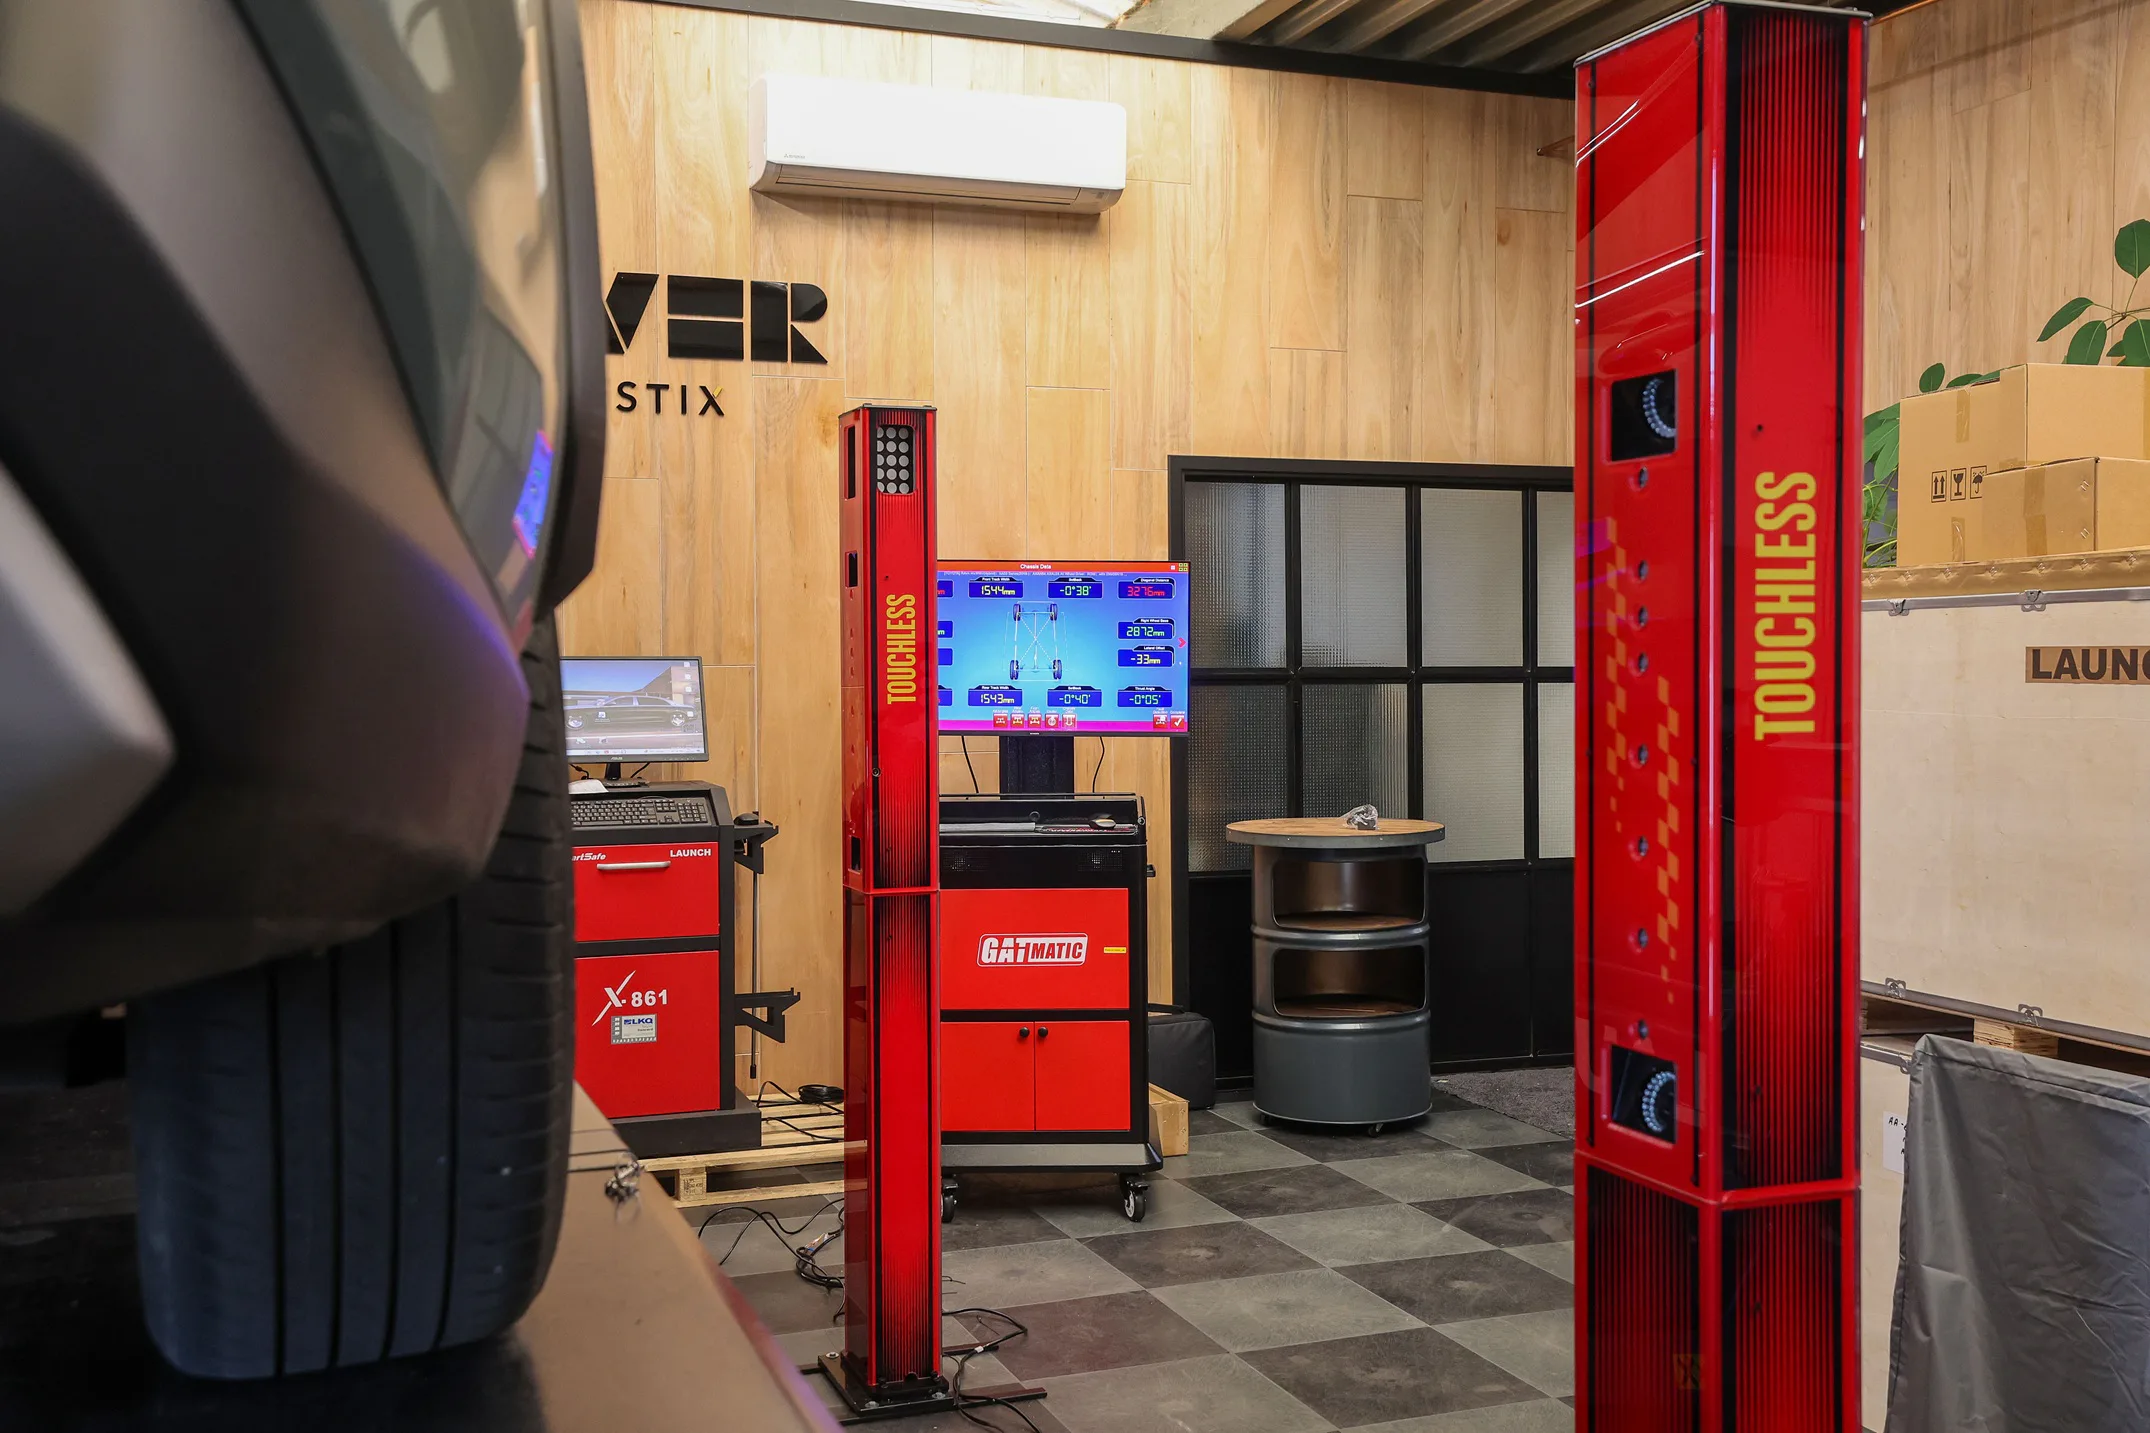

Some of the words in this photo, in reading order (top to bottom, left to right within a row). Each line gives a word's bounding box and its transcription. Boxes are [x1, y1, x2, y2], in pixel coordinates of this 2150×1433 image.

[981, 585, 1016, 596] 1544mm
[1127, 586, 1166, 597] 3276mm
[1754, 471, 1817, 741] TOUCHLESS
[1126, 626, 1165, 637] 2872mm
[886, 593, 916, 705] TOUCHLESS
[980, 694, 1015, 704] 1543mm
[670, 848, 711, 858] LAUNCH
